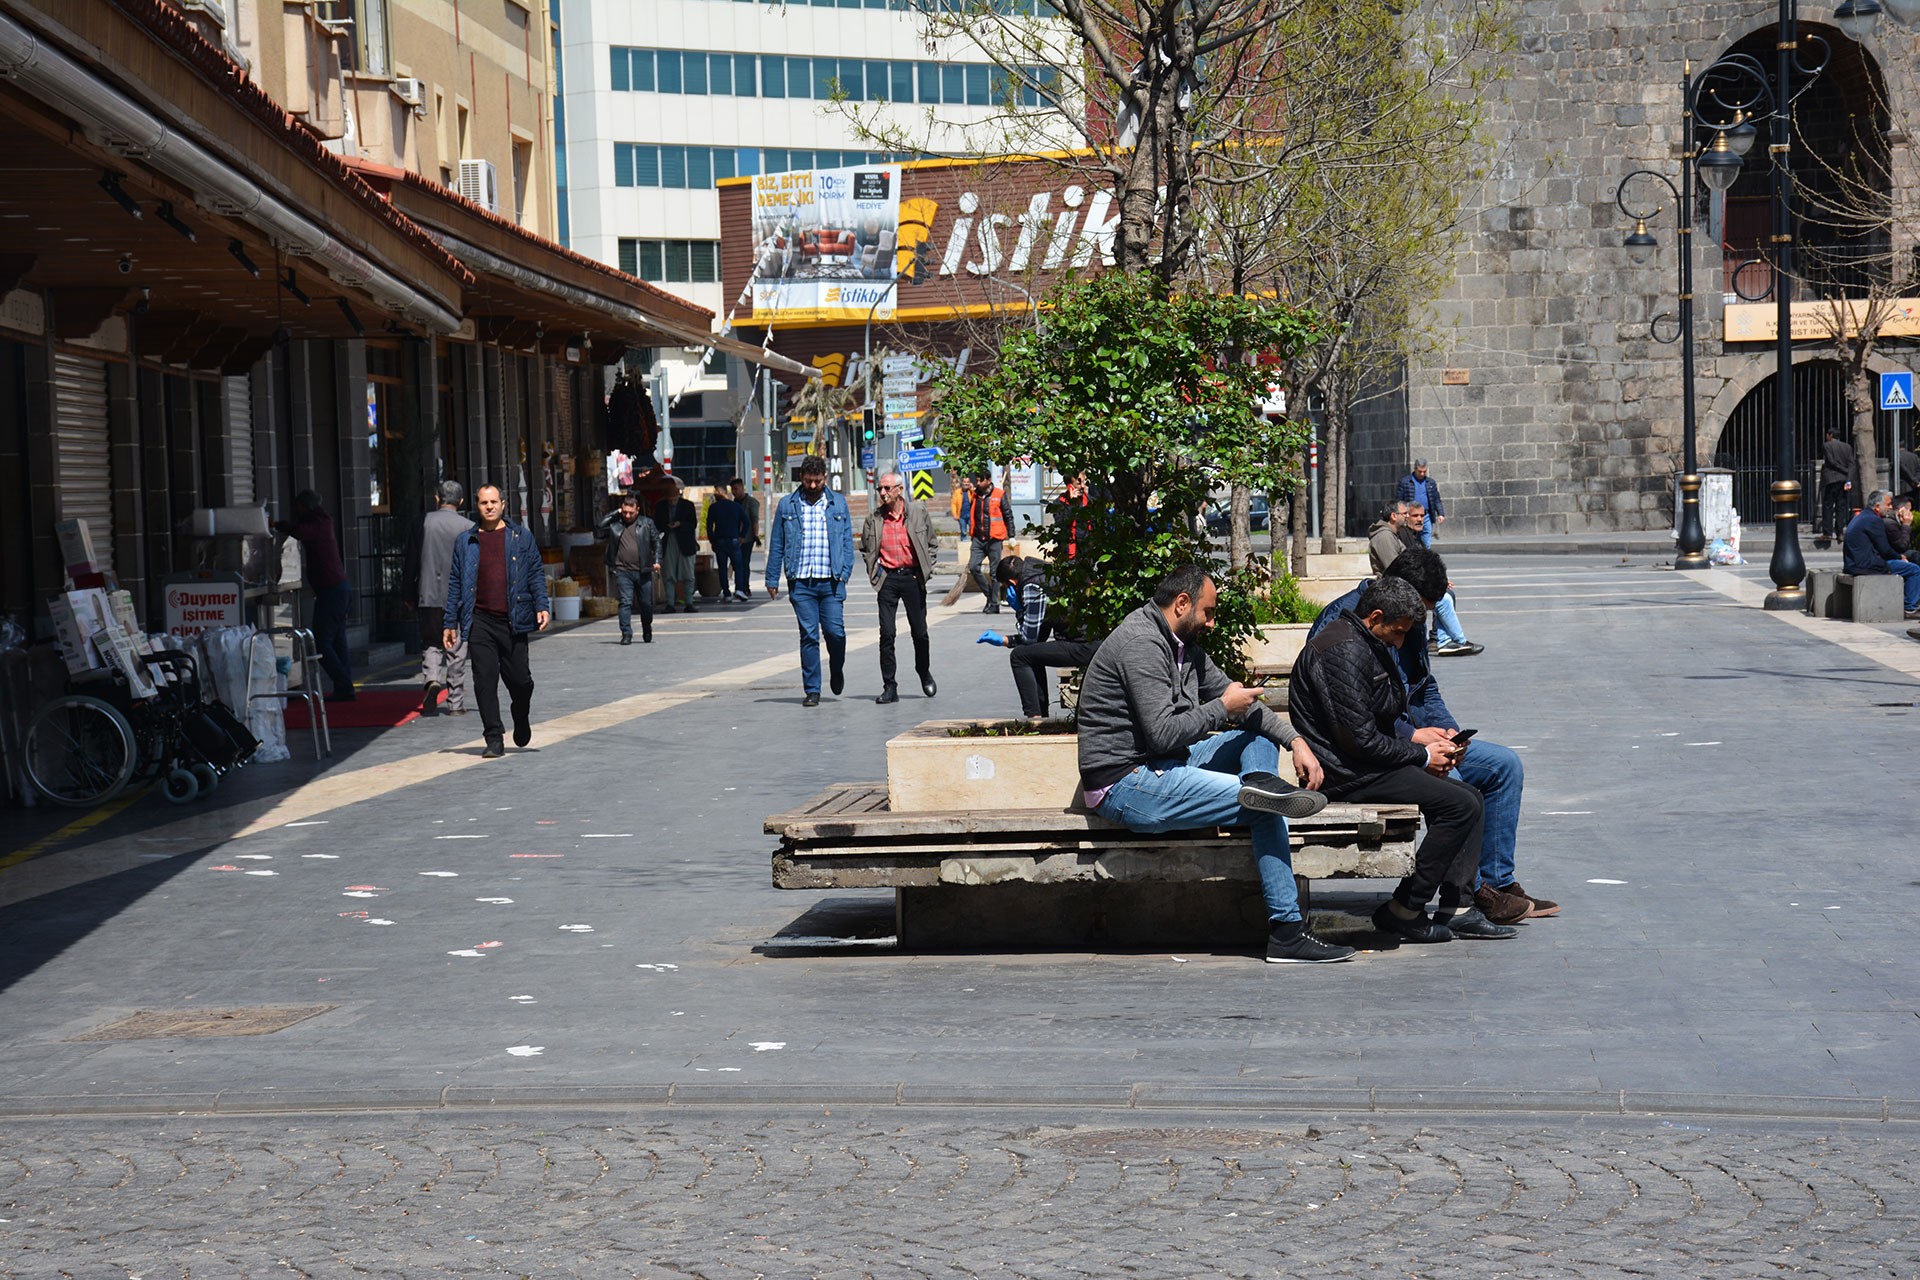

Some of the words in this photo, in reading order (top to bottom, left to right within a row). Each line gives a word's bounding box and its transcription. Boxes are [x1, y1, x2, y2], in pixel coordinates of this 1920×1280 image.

[781, 171, 812, 189] BİTTİ
[820, 176, 833, 189] 10
[180, 592, 237, 607] Duymer
[183, 608, 224, 622] İŞİTME
